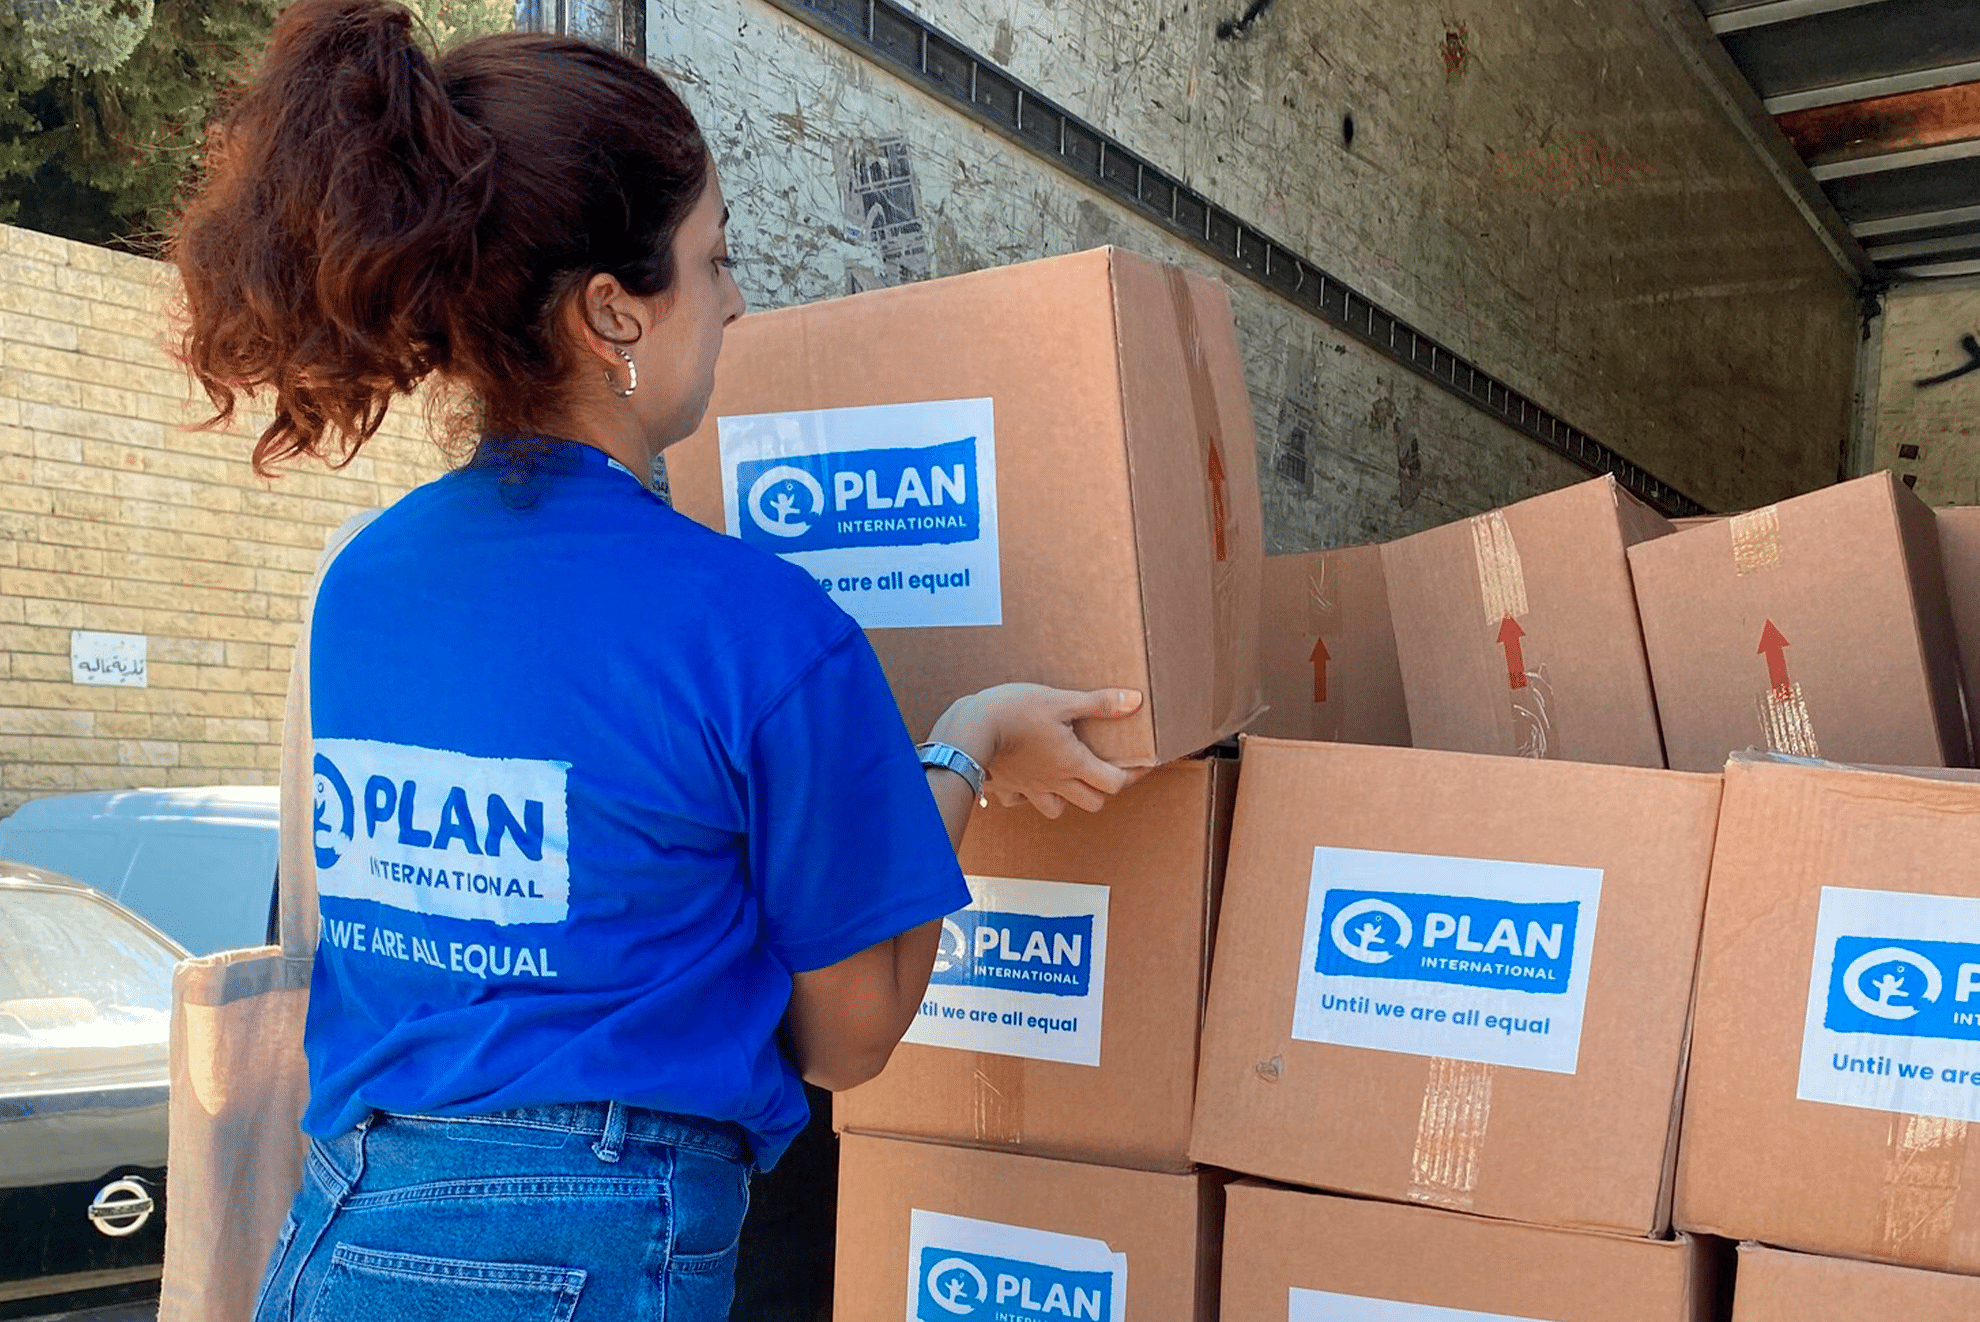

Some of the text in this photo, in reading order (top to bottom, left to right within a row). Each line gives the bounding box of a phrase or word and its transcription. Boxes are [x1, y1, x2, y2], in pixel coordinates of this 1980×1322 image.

[835, 464, 965, 510] PLAN
[838, 515, 968, 532] INTERNATIONAL
[816, 568, 969, 594] e are all equal
[364, 774, 544, 862] PLAN
[330, 920, 365, 951] WE
[372, 928, 409, 960] ARE
[412, 937, 446, 968] ALL
[450, 943, 556, 979] EQUAL
[974, 926, 1082, 967] PLAN
[1422, 912, 1563, 960] PLAN
[974, 965, 1080, 985] INTERNATIONAL
[1421, 957, 1557, 980] INTERNATIONAL
[918, 1001, 1077, 1034] til we are all equal
[1322, 994, 1550, 1035] Until we are all equal
[1833, 1054, 1980, 1086] Until we are
[996, 1273, 1101, 1322] PLAN
